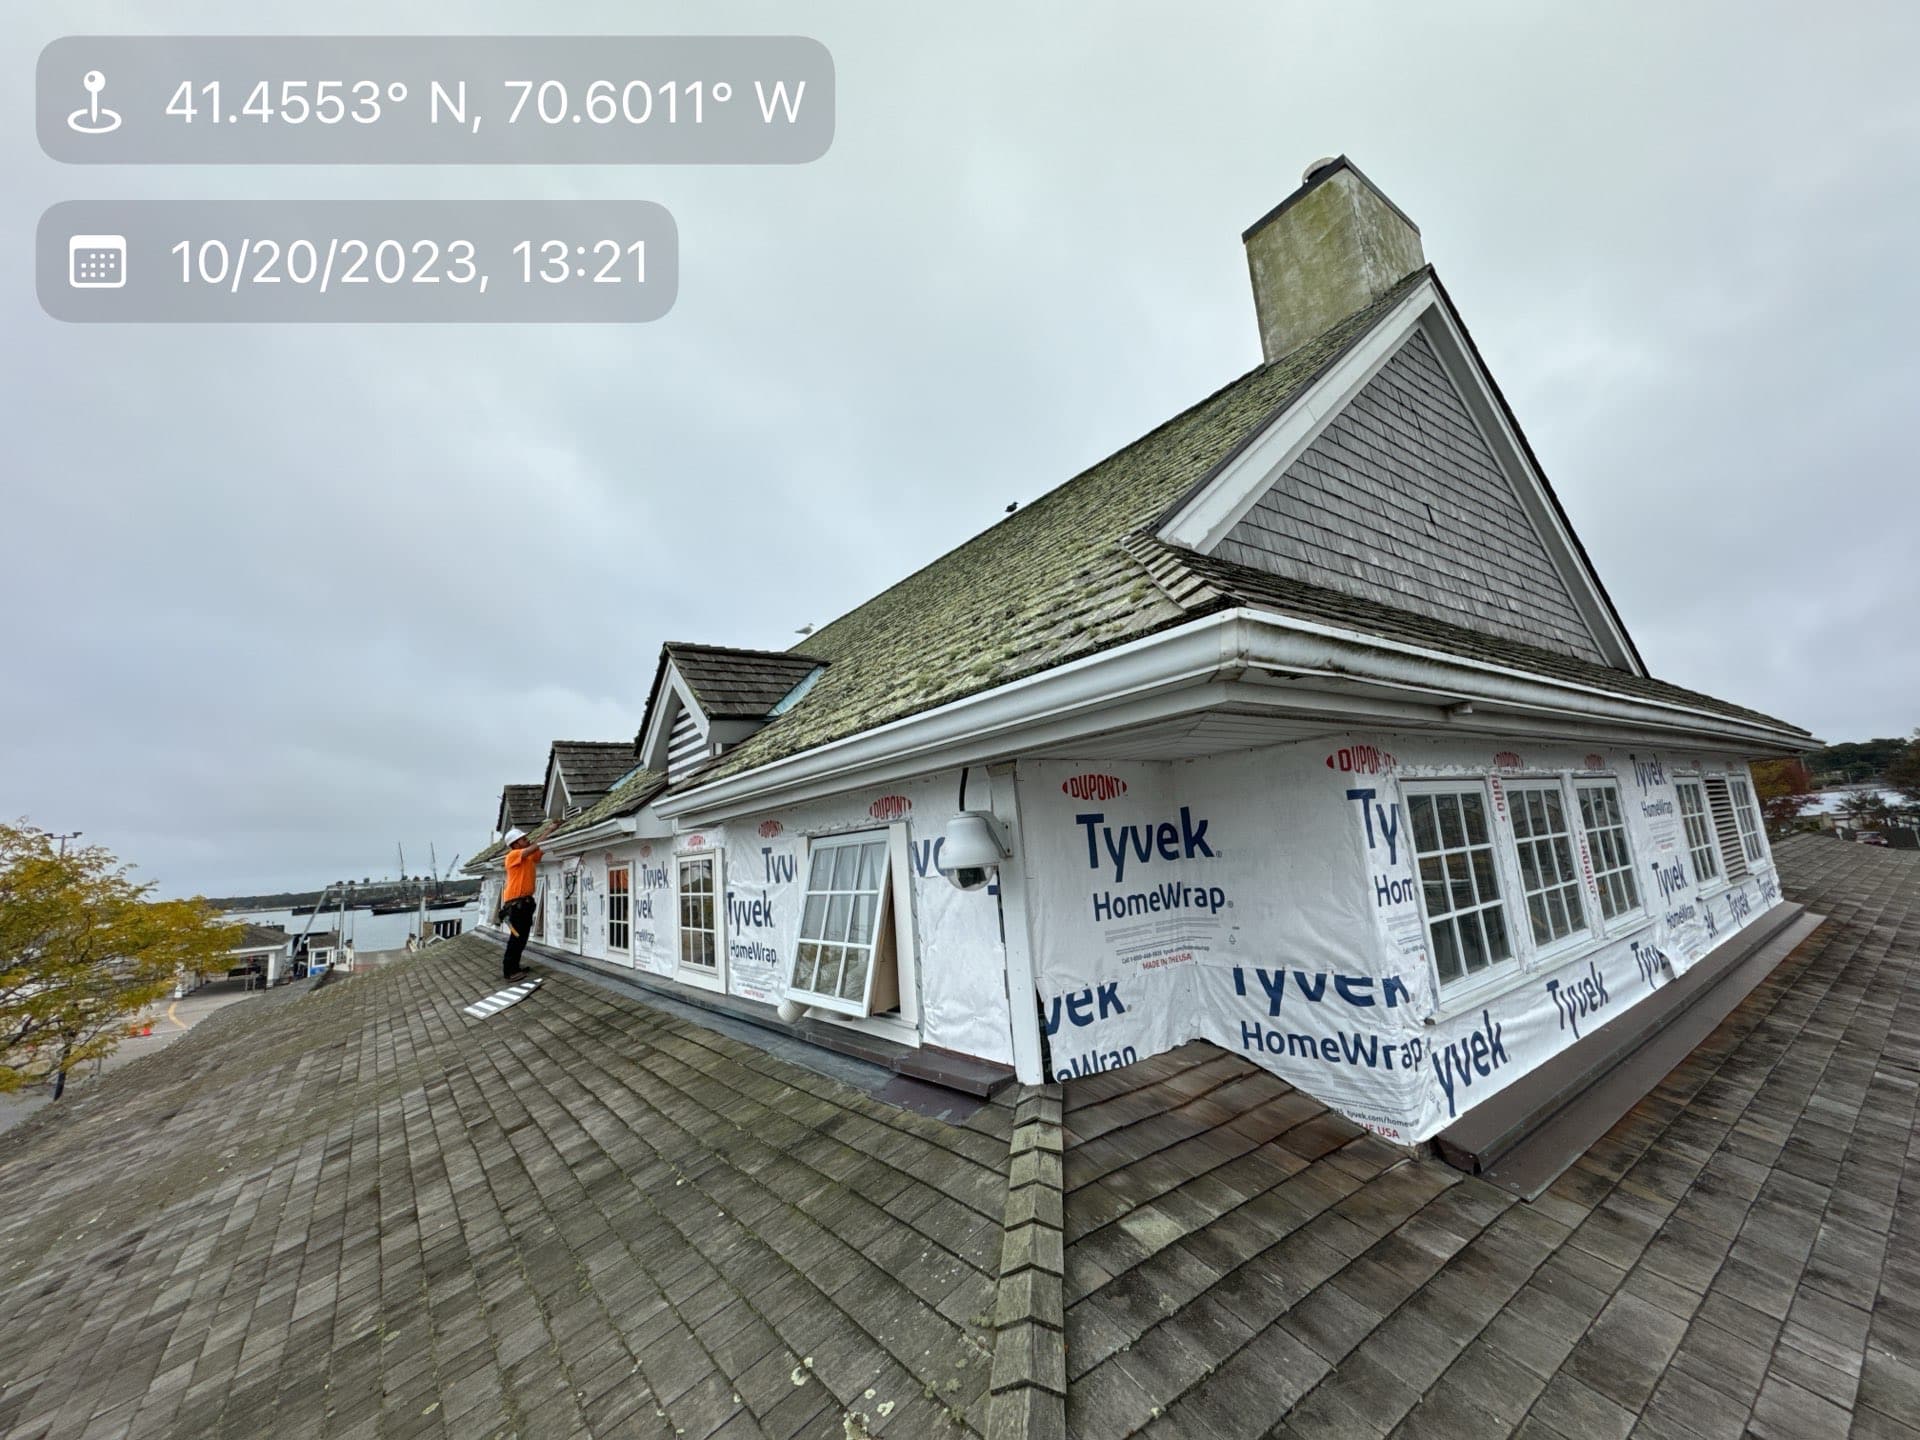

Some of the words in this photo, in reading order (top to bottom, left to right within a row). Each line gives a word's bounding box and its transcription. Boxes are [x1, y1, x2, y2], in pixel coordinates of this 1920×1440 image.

[1070, 774, 1121, 801] DUPONT
[1629, 753, 1667, 796] Tyvek
[873, 795, 907, 820] DUPONT
[1076, 806, 1215, 883] Tyvek
[1093, 881, 1226, 922] HomeWrap
[1651, 855, 1688, 905] Tyvek
[727, 890, 773, 936] Tyvek
[729, 940, 777, 968] HomeWrap
[1546, 961, 1609, 1040] Tyvek
[1241, 1021, 1422, 1072] HomeWrap
[1377, 1125, 1401, 1139] USA
